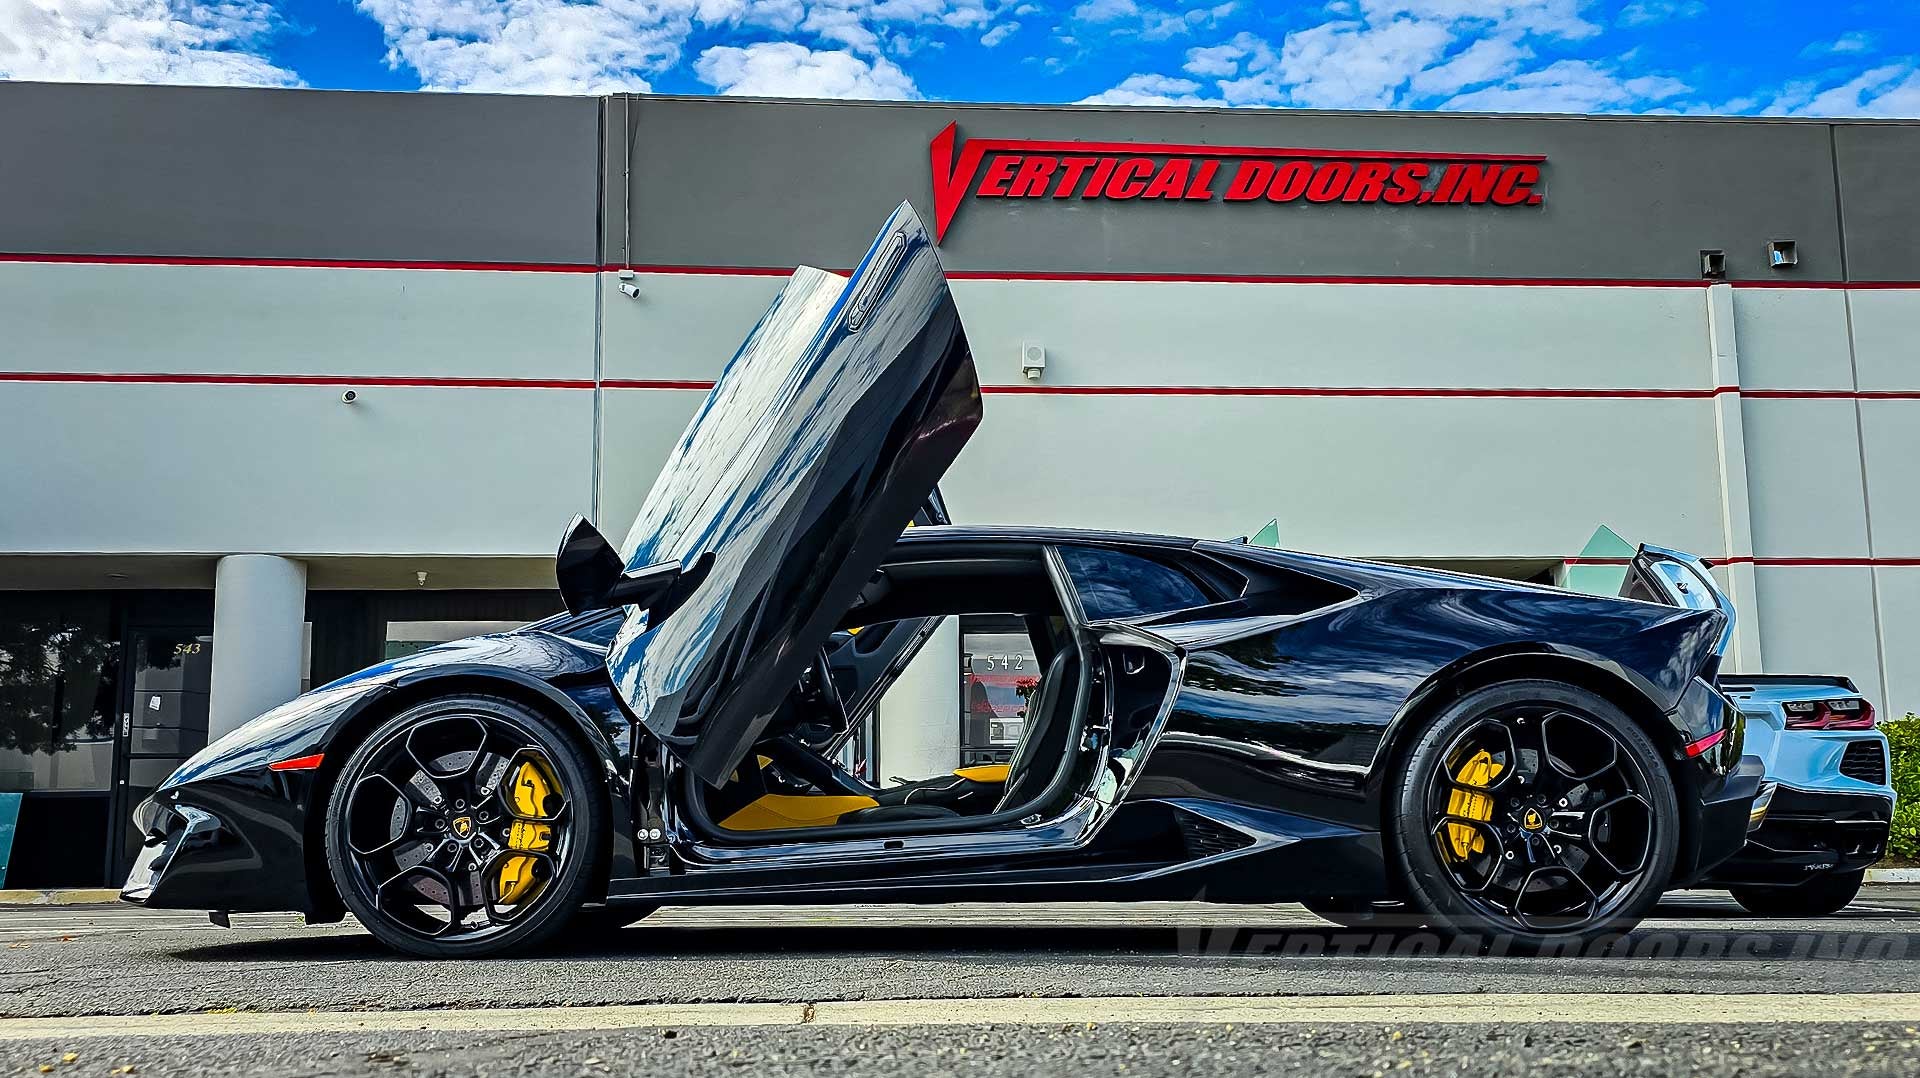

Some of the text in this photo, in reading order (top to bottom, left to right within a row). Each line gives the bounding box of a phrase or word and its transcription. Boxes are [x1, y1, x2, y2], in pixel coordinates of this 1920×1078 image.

[930, 120, 1220, 246] VERTICAL
[173, 643, 201, 654] 543
[987, 654, 1024, 671] 542
